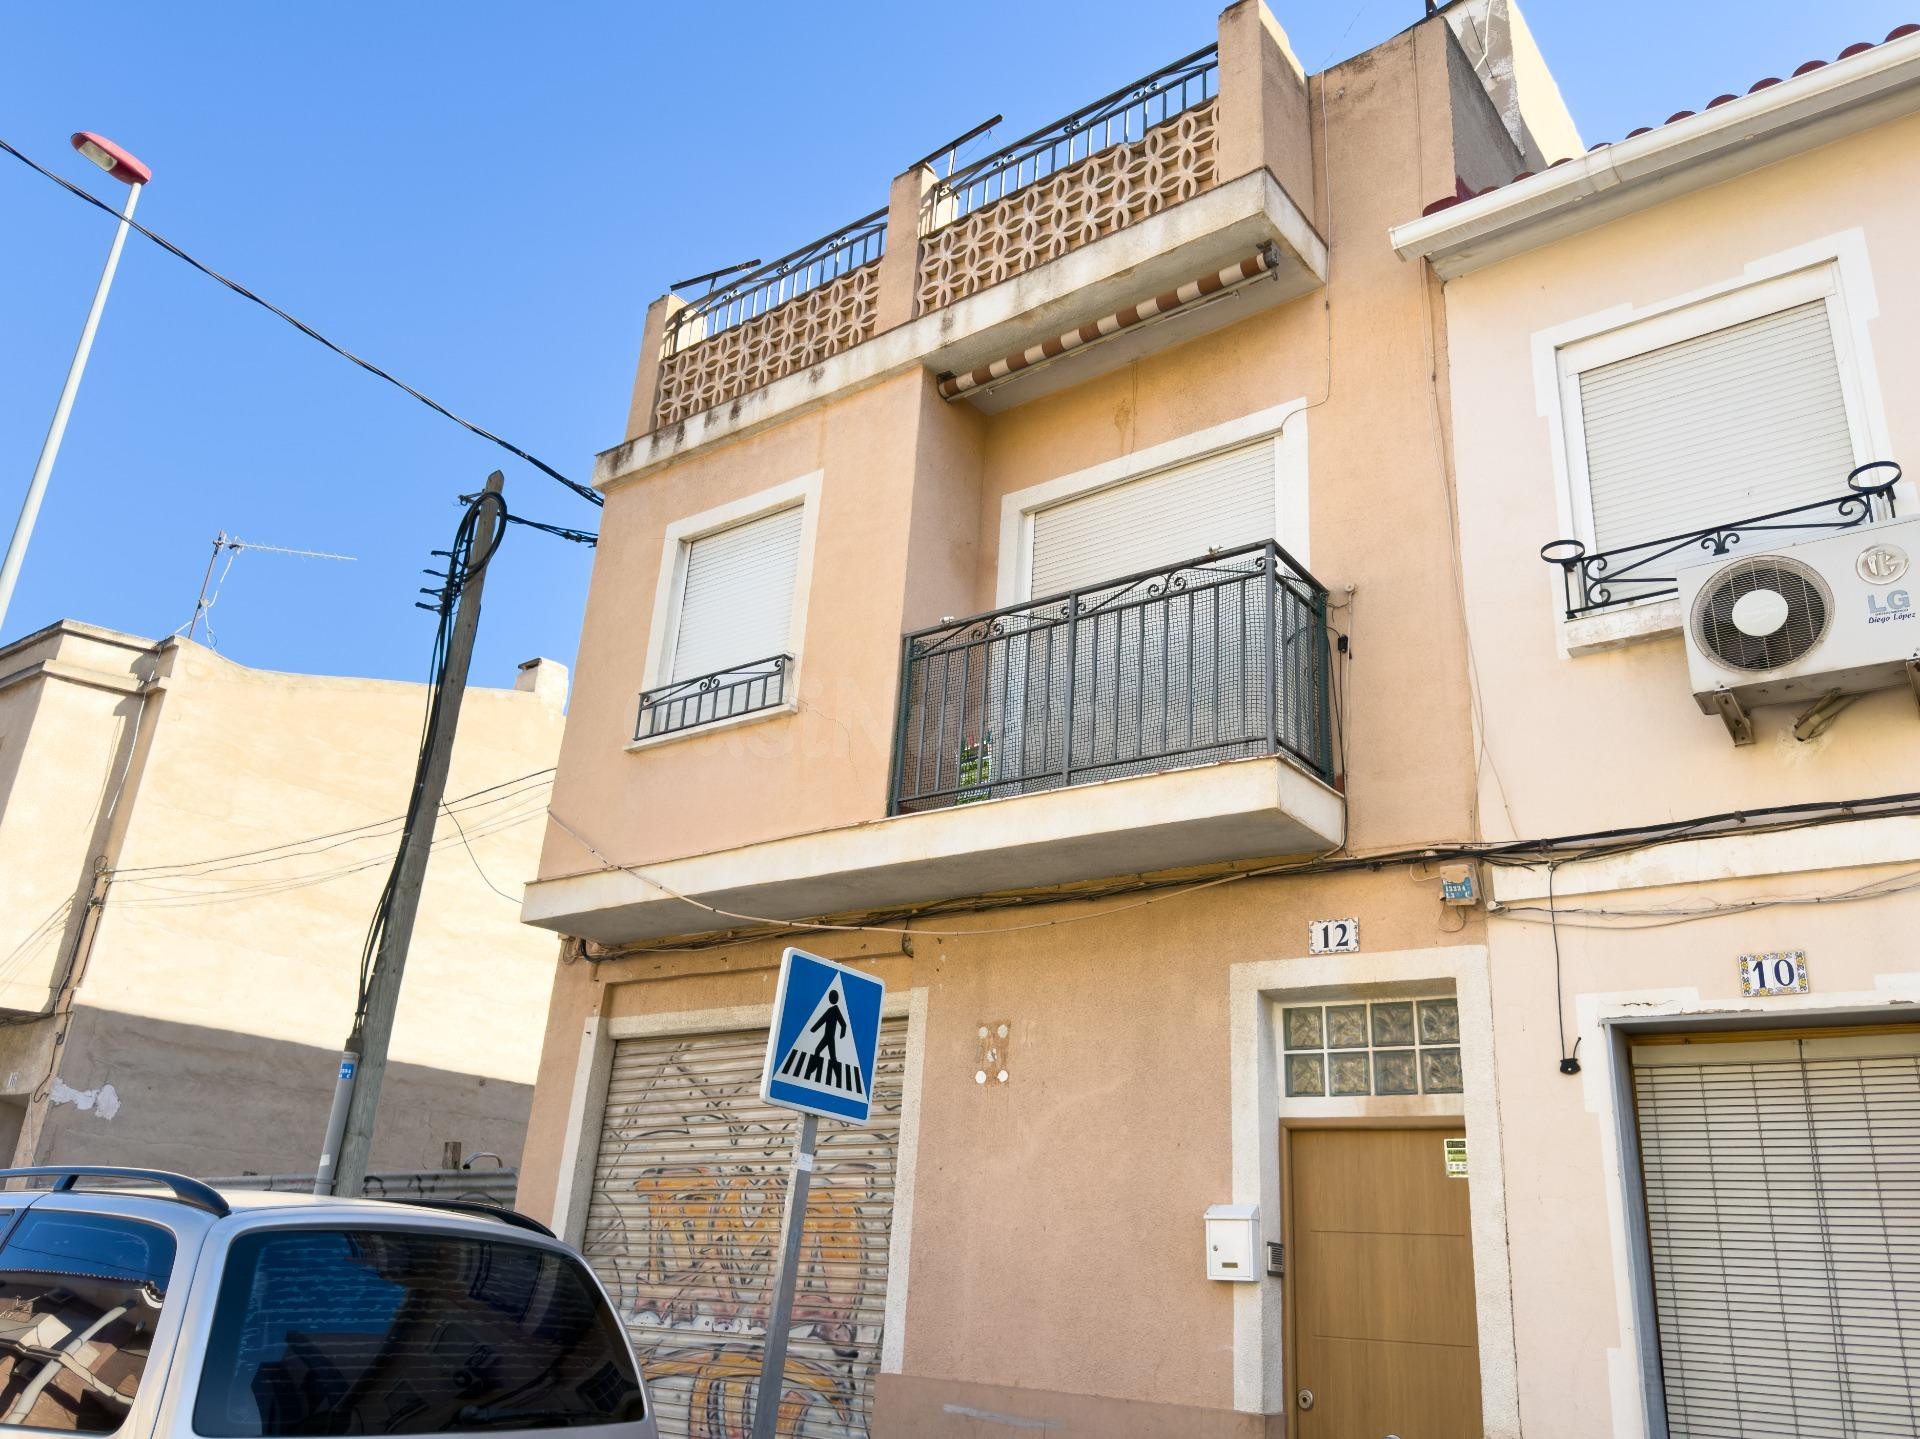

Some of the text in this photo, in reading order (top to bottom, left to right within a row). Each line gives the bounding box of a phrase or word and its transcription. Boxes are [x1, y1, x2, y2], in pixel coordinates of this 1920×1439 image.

[1867, 589, 1910, 614] LG
[1868, 616, 1891, 624] Diego
[1322, 923, 1349, 949] 12
[1752, 959, 1795, 989] 10
